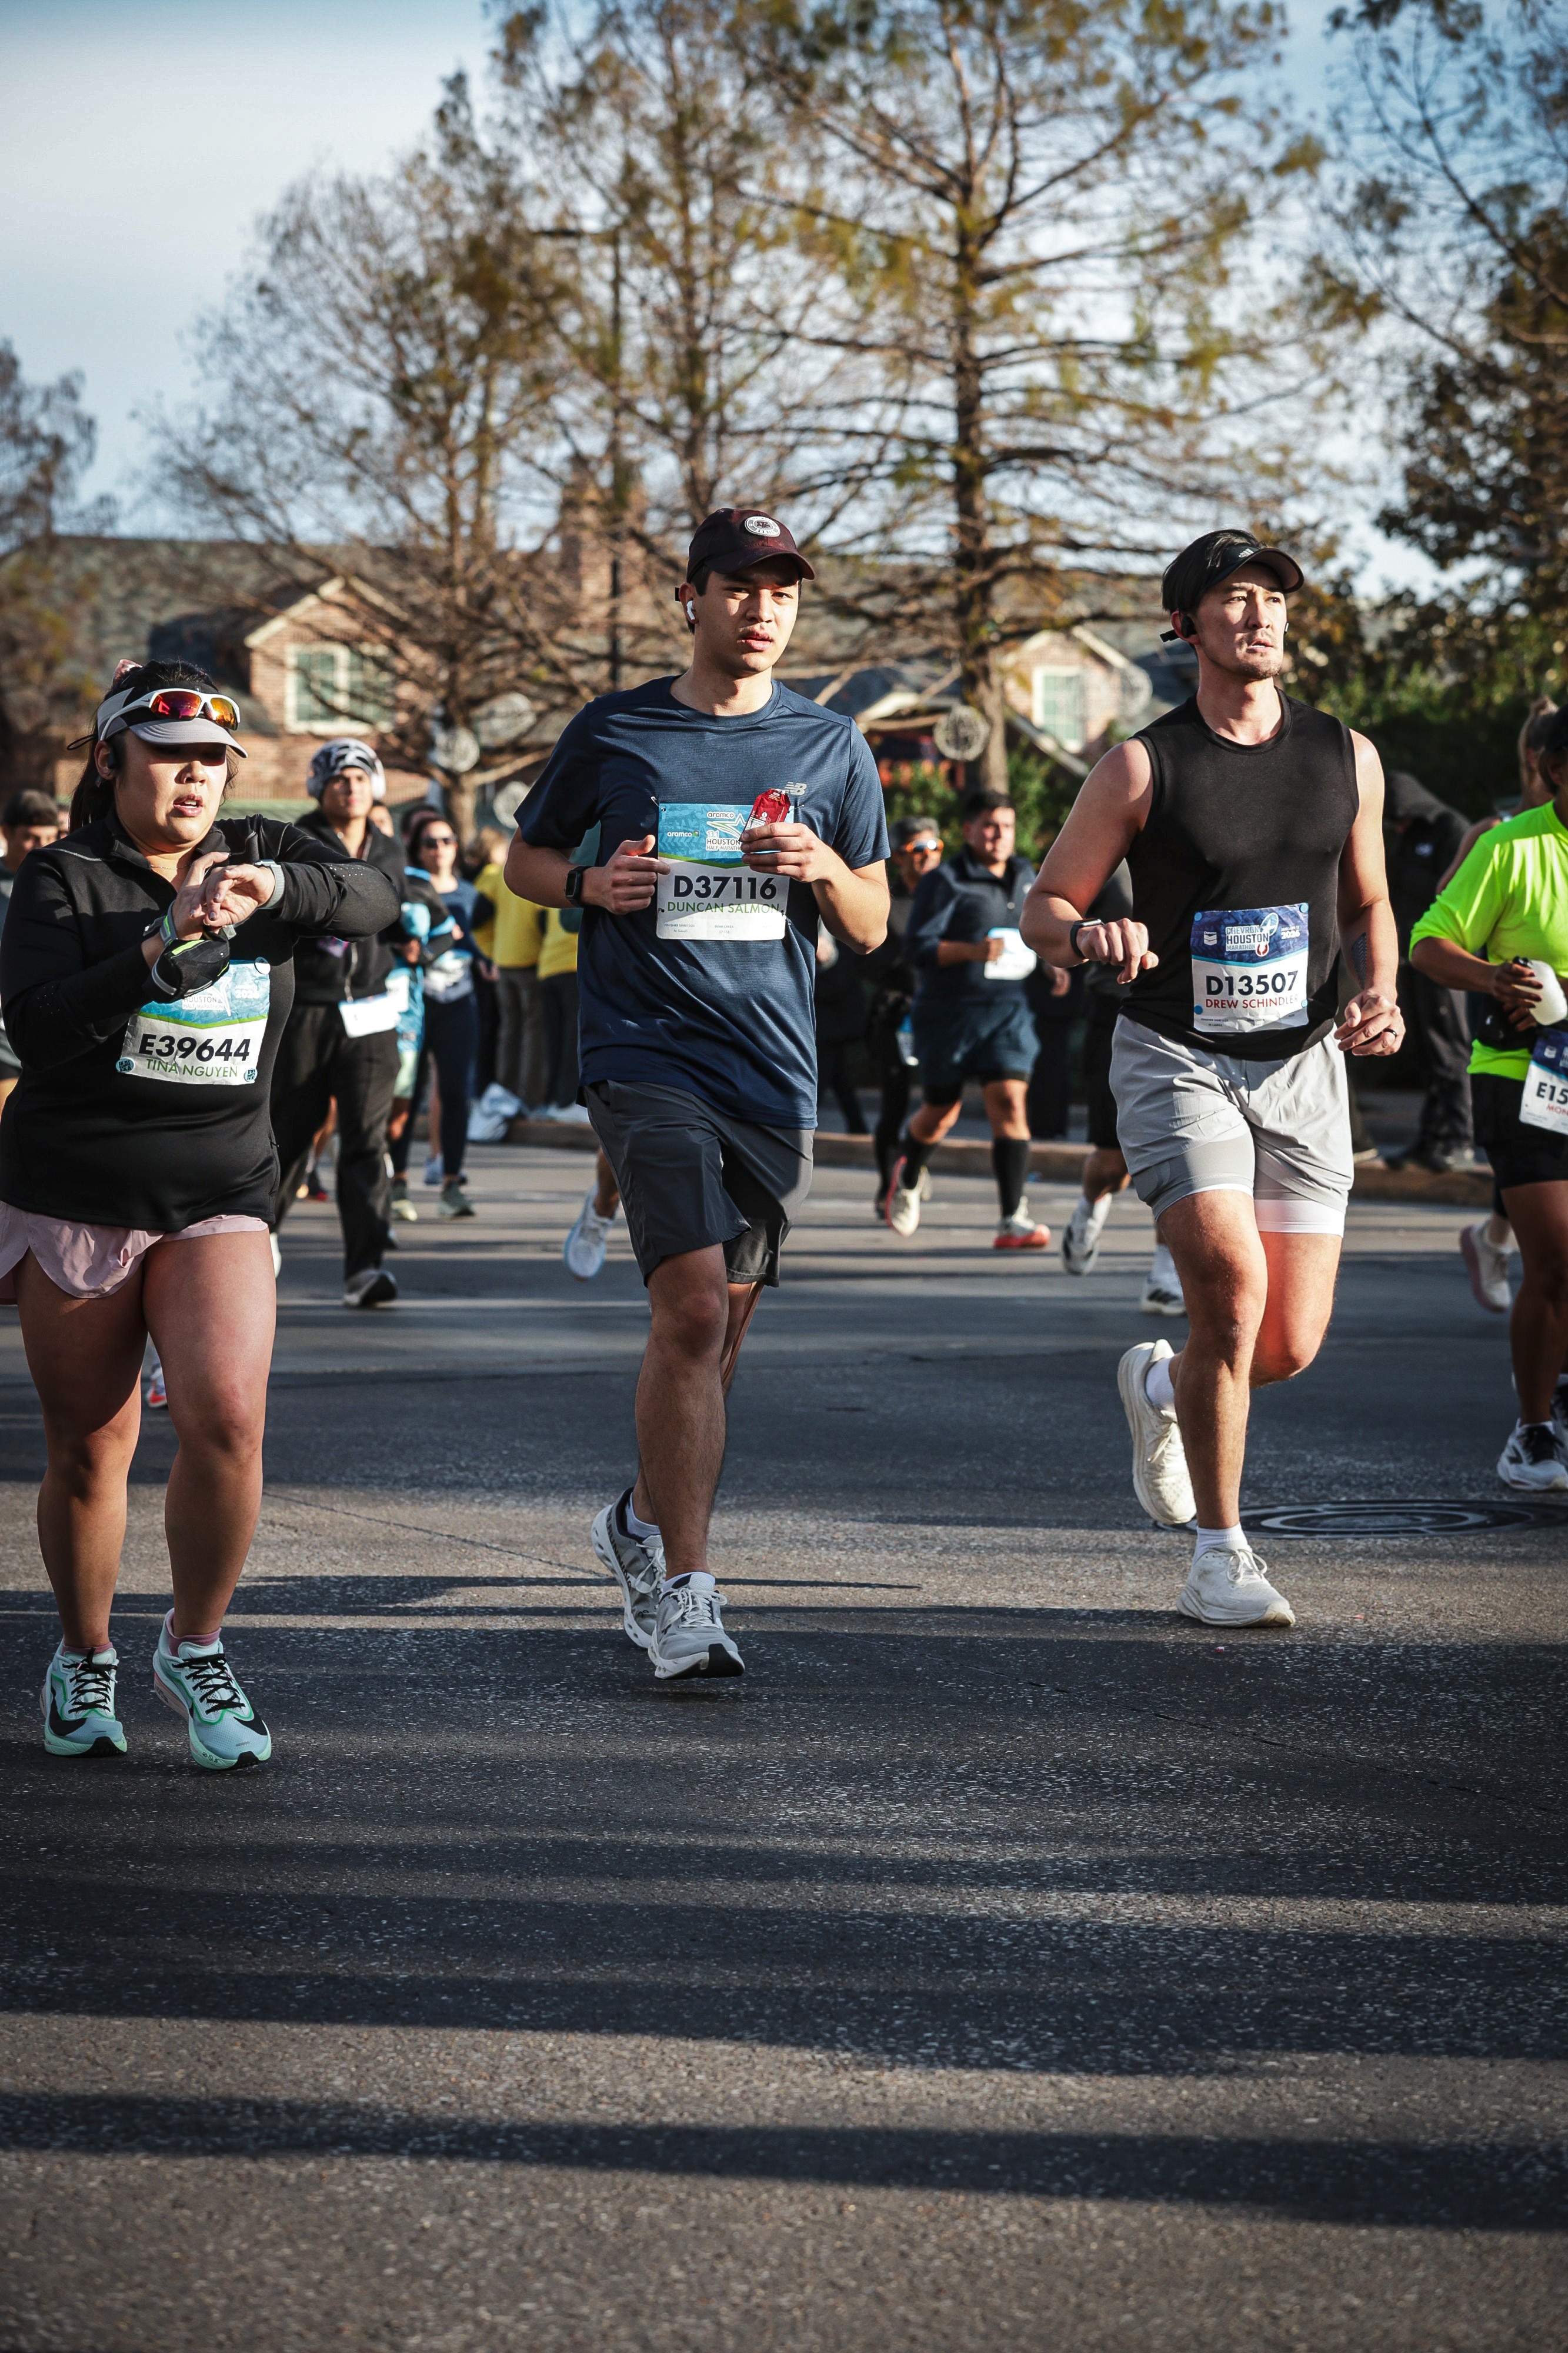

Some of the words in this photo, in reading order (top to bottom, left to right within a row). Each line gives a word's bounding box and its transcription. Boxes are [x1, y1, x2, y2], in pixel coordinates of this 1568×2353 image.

[673, 875, 777, 899] D37116
[668, 902, 723, 912] DUNCAN
[728, 903, 779, 914] SALMON
[1226, 926, 1261, 935] CHEVRON
[1281, 929, 1300, 939] 2026
[1226, 934, 1269, 945] HOUSTON
[1206, 970, 1299, 996] D13507
[1206, 998, 1239, 1009] DREW
[1242, 994, 1298, 1009] SCHINDLER
[138, 1033, 251, 1062] E39644
[146, 1058, 179, 1074] TINA
[182, 1065, 238, 1077] NGUYEN
